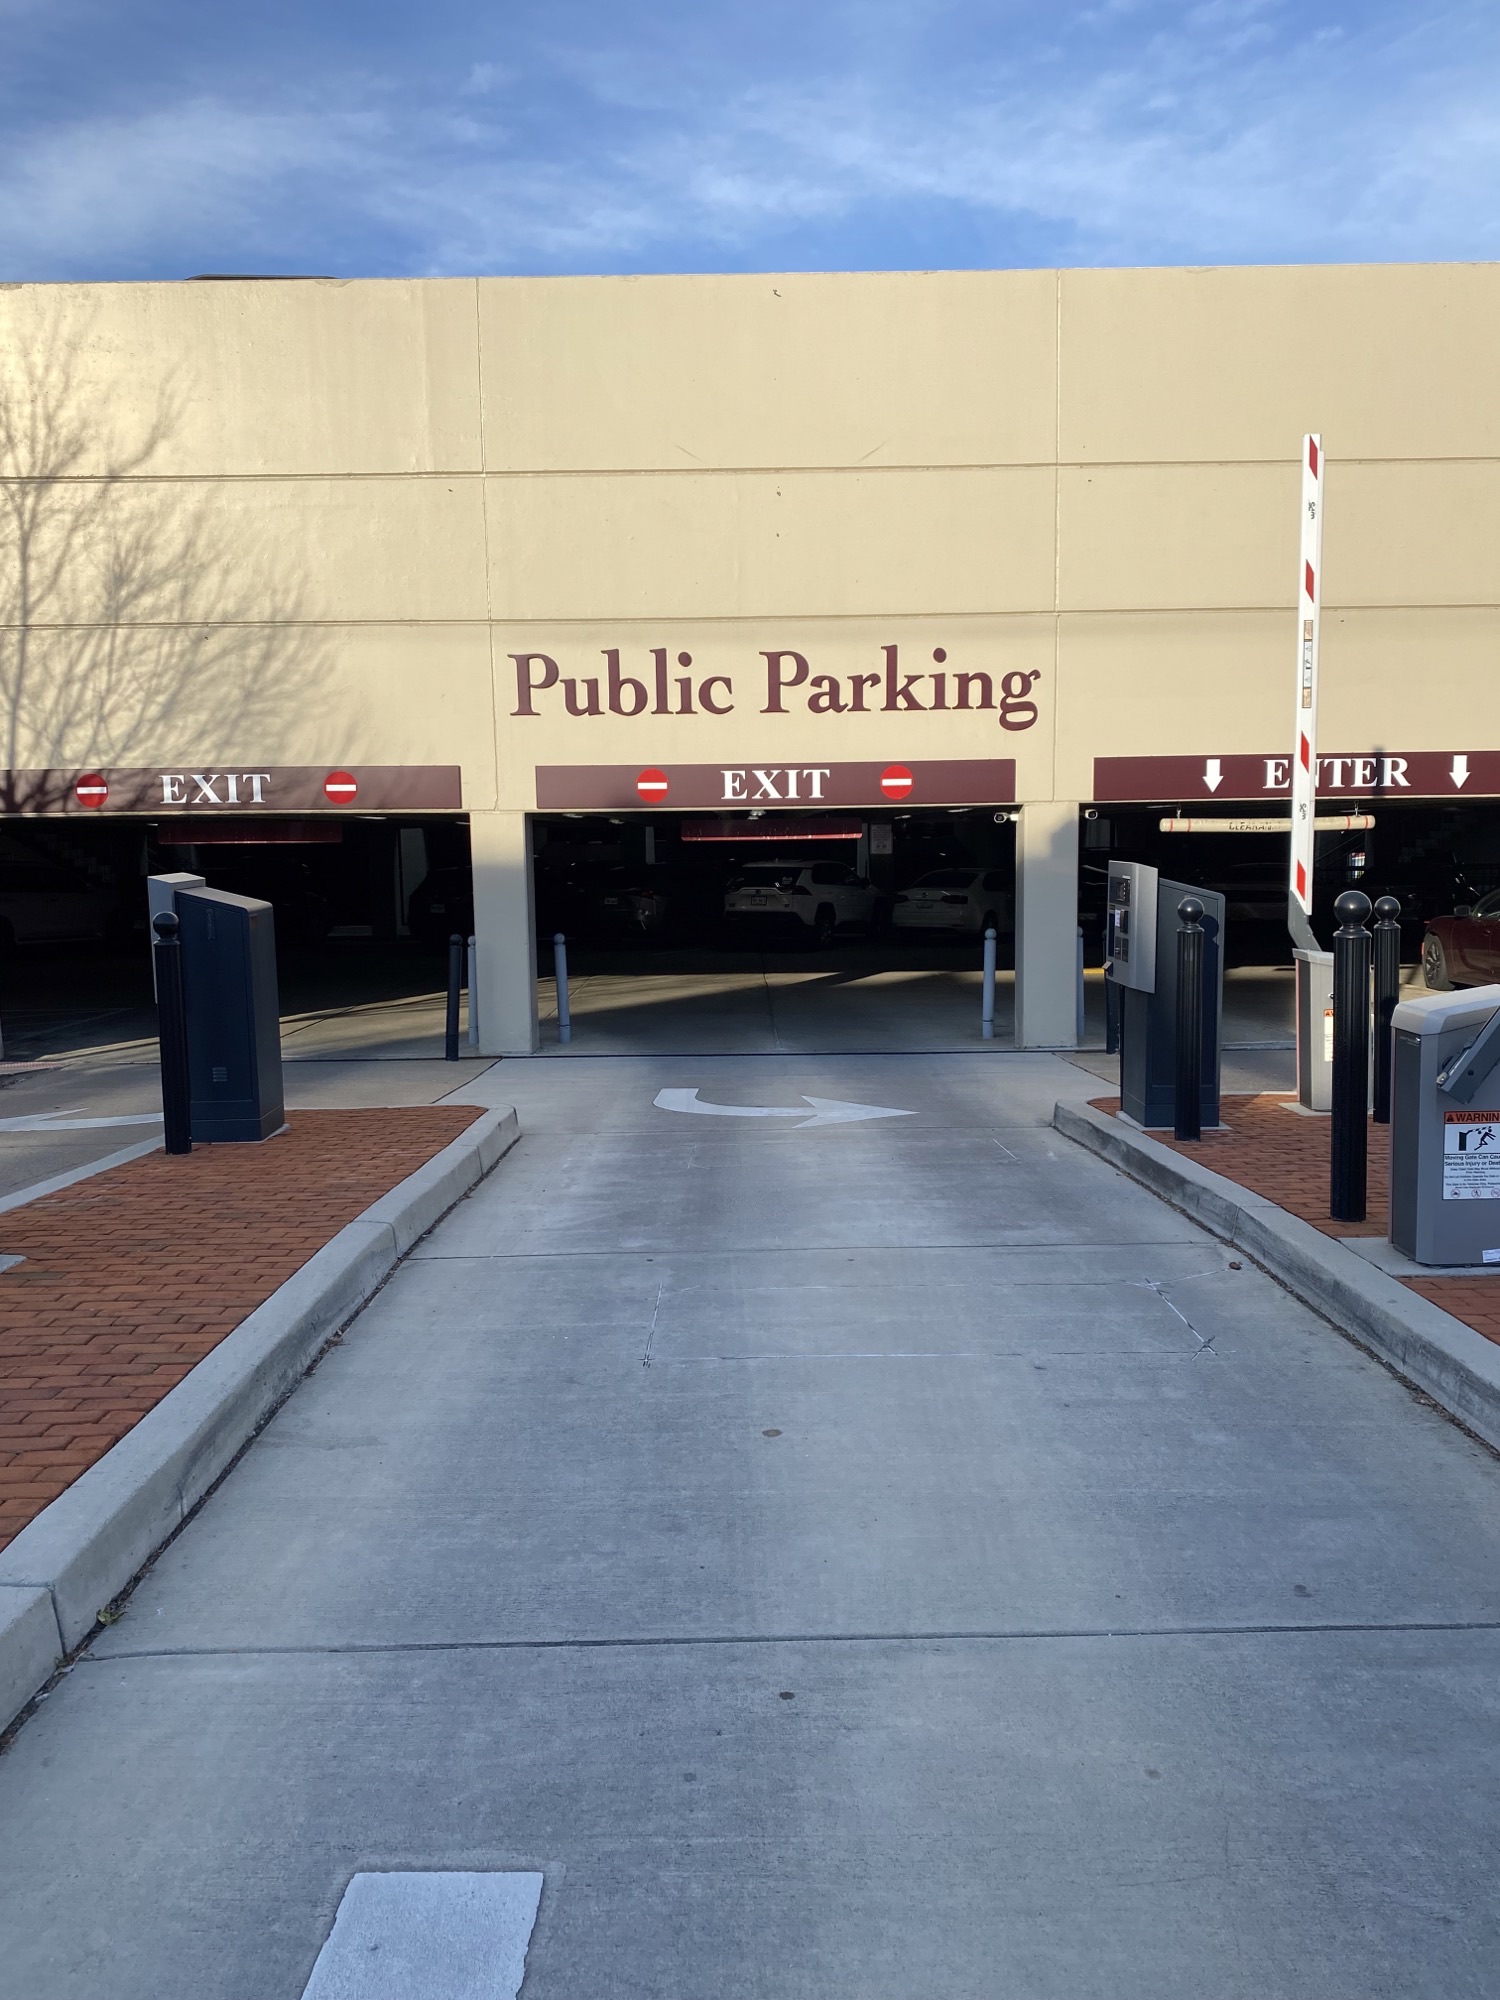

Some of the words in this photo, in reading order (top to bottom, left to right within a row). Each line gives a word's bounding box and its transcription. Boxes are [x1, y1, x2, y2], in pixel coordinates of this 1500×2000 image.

[509, 648, 735, 717] Public
[758, 645, 1041, 732] Parking
[160, 773, 271, 804] EXIT
[720, 768, 831, 801] EXIT
